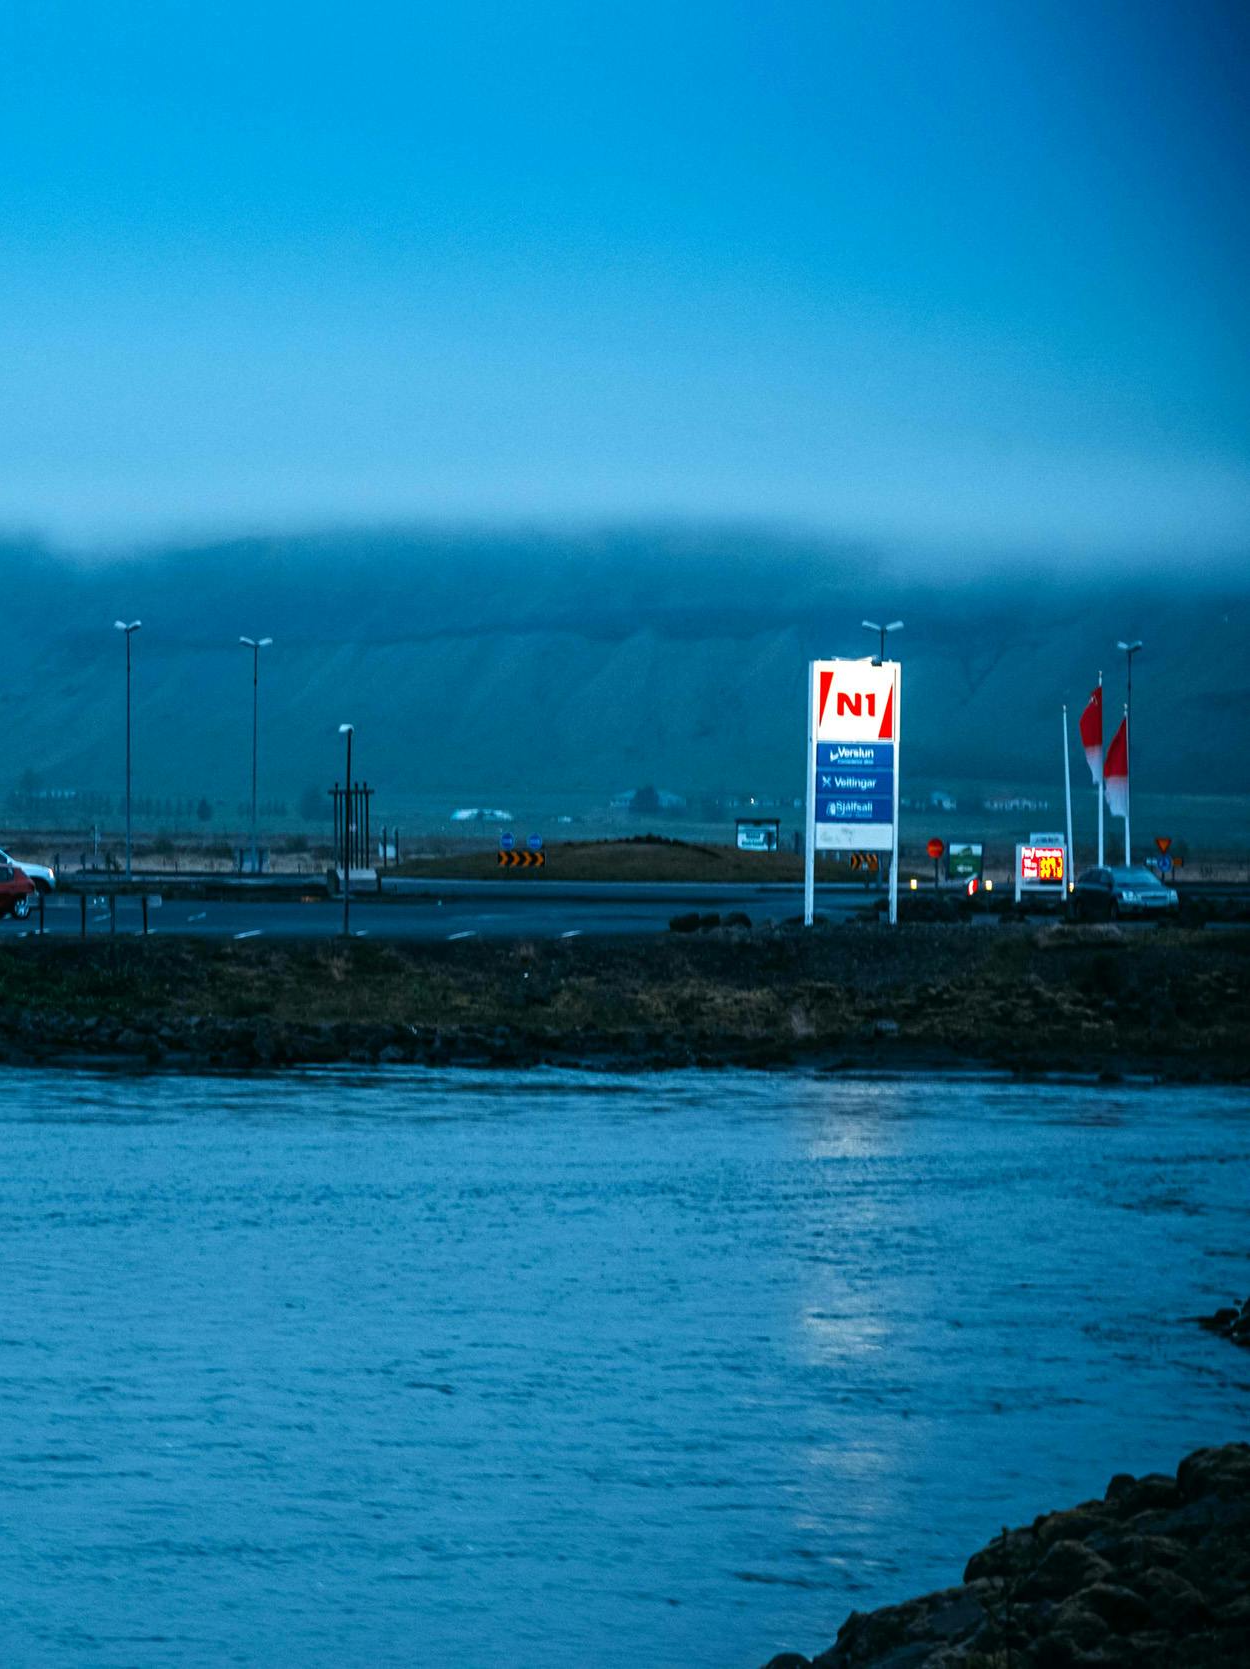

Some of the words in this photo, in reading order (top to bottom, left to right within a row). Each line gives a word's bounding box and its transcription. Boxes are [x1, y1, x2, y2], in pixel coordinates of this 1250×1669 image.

[837, 692, 875, 717] N1
[838, 746, 874, 758] Verslun
[835, 776, 877, 791] Veitingar
